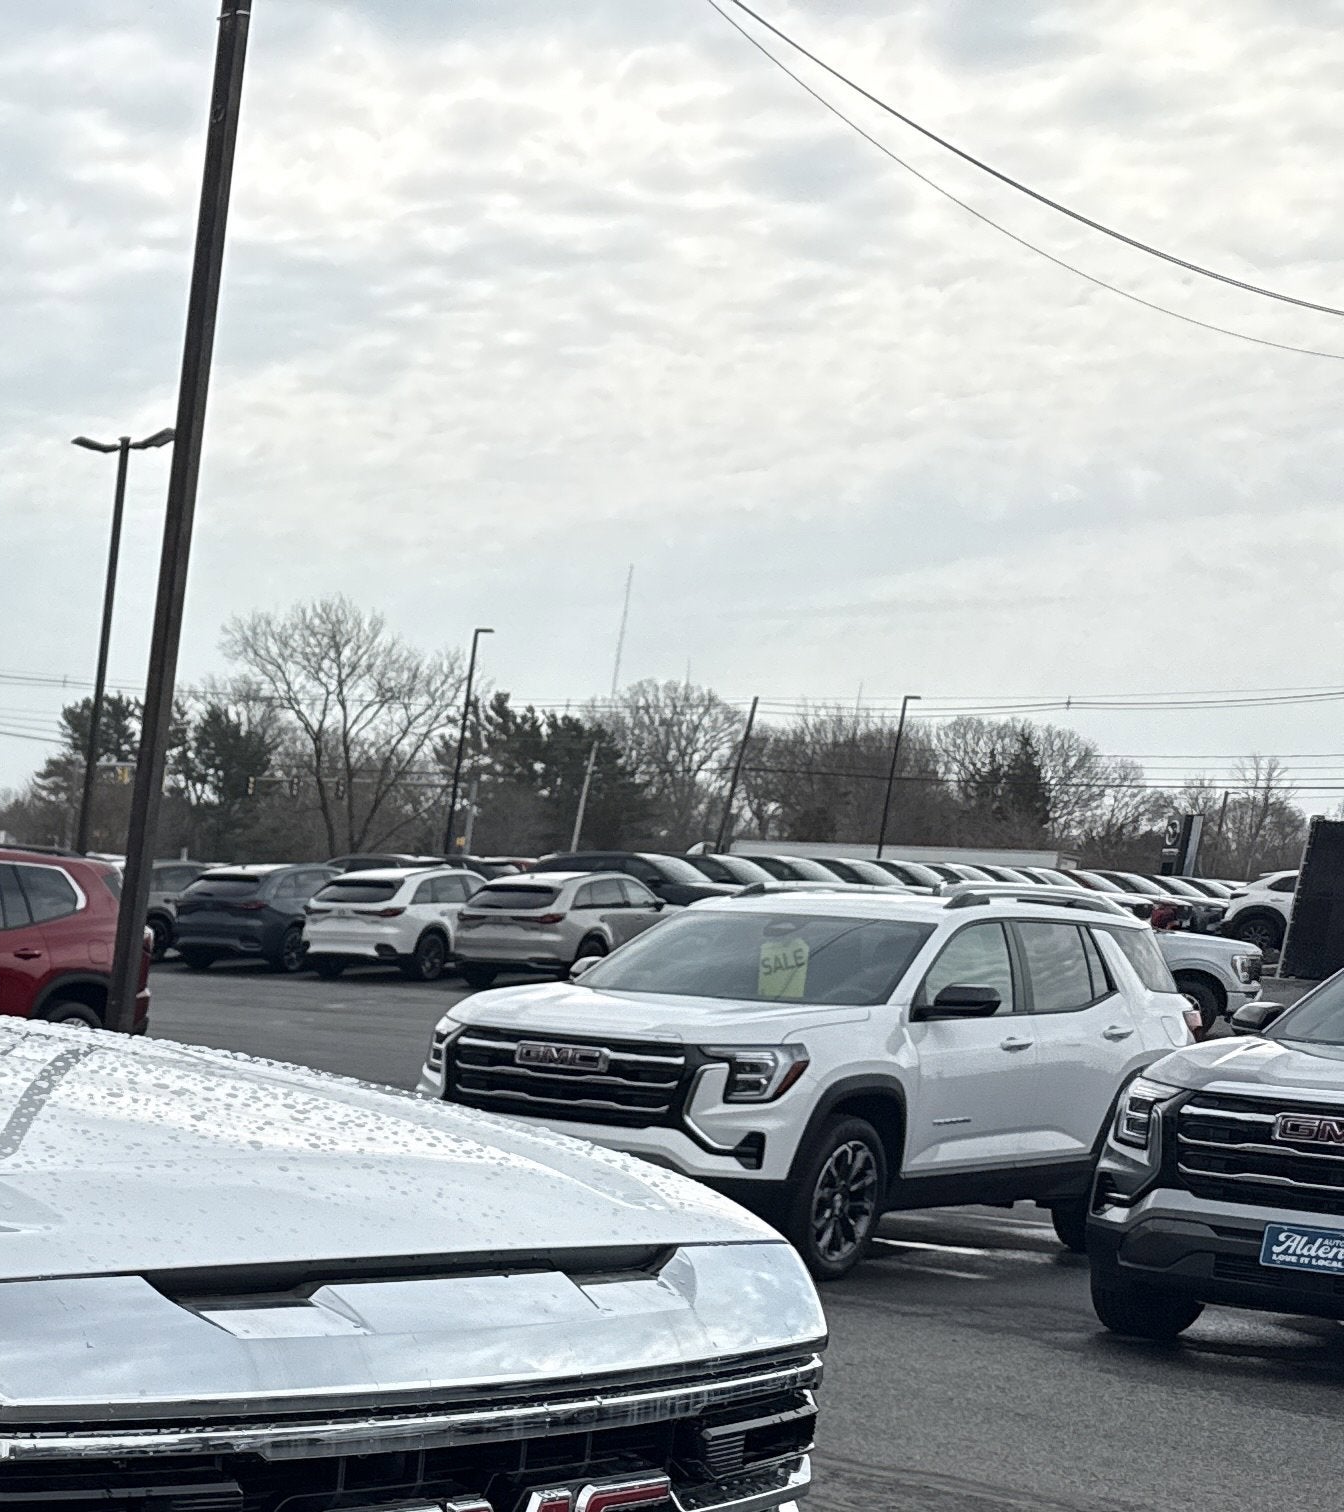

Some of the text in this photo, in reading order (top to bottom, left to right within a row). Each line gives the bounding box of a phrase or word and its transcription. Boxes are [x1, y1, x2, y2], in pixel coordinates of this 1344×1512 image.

[761, 948, 805, 976] SALE
[520, 1044, 601, 1069] GMC
[1280, 1118, 1344, 1143] GM
[1272, 1231, 1344, 1260] Alden
[1271, 1252, 1344, 1269] LOVE IT LOCAL
